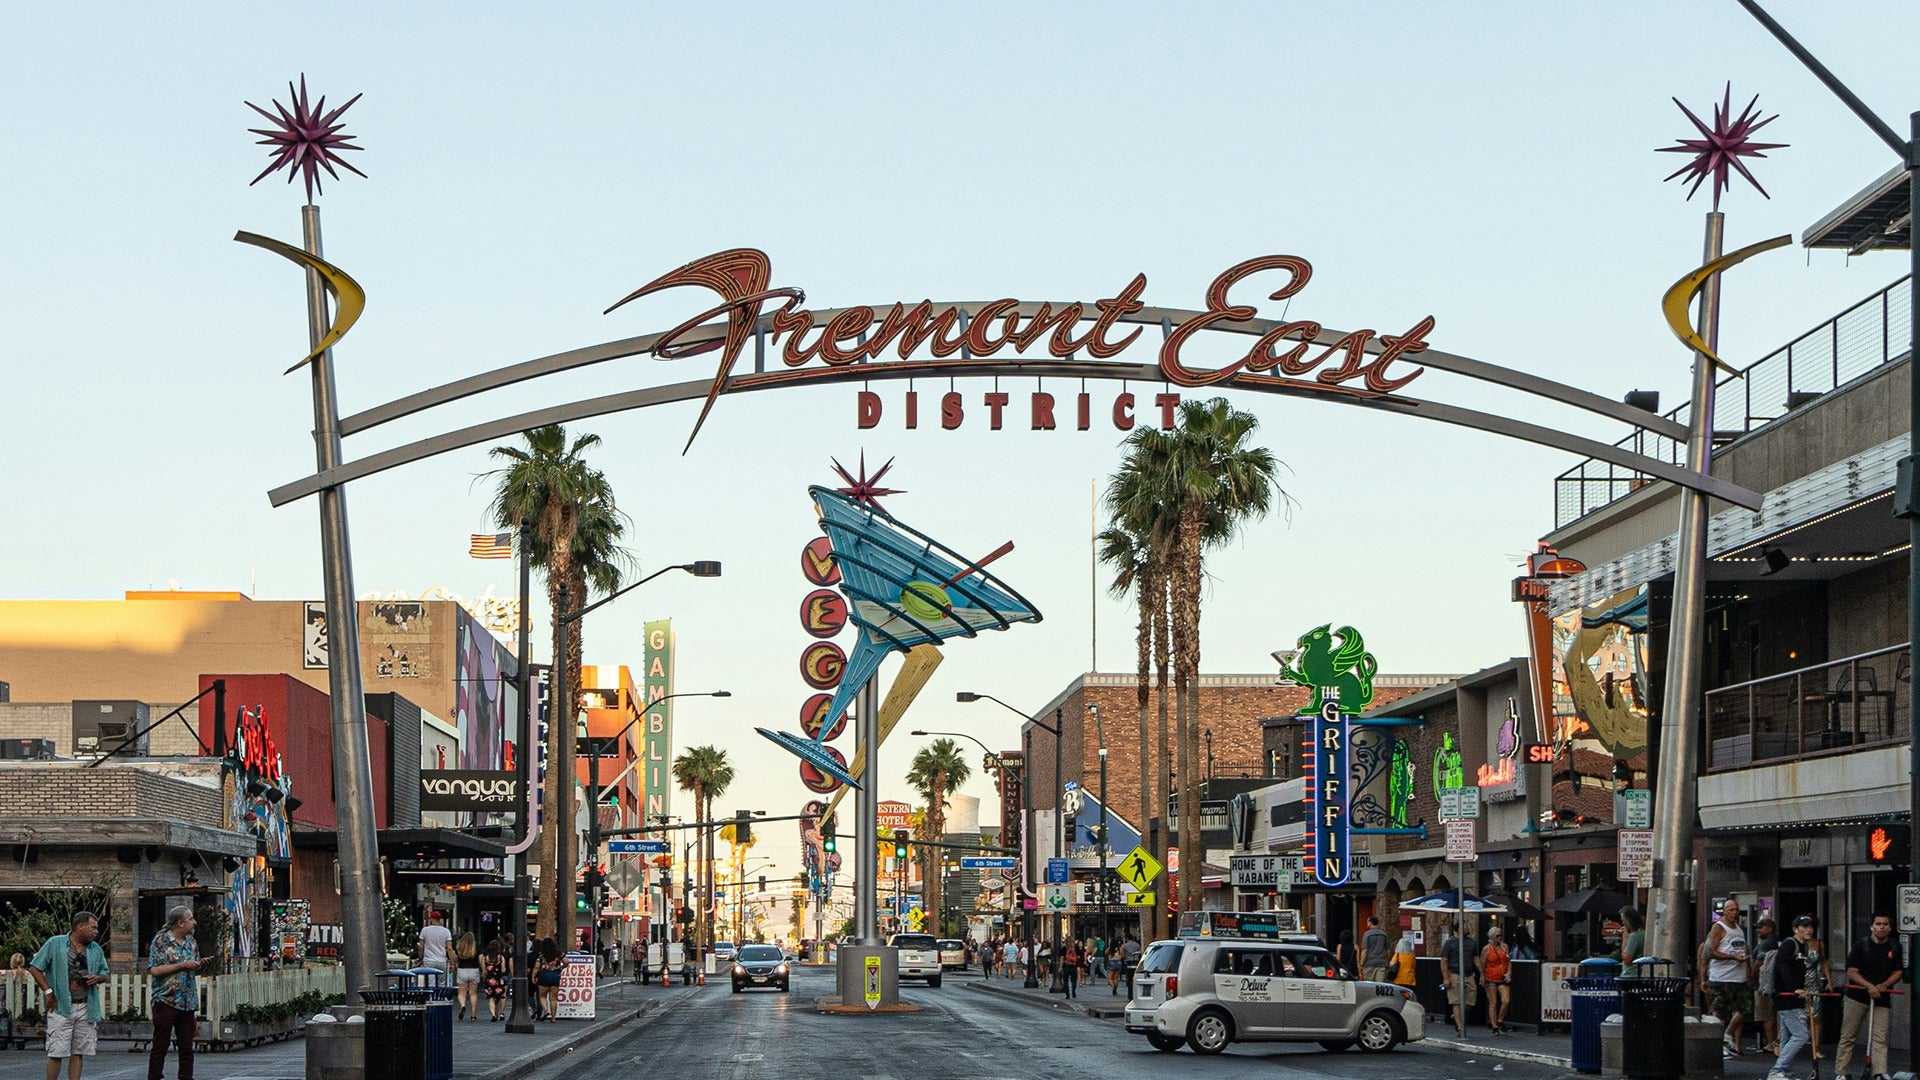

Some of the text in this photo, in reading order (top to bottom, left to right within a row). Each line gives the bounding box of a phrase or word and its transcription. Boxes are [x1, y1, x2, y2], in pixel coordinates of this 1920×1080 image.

[603, 247, 1435, 457] Fremont East
[858, 391, 1181, 431] DISTRICT
[1321, 686, 1340, 699] THE
[422, 779, 517, 801] vanguar
[1321, 702, 1341, 879] GRIFFIN
[877, 803, 910, 814] ESTERN
[624, 842, 656, 851] 6th Street
[1232, 859, 1256, 871] HOME
[1263, 858, 1275, 870] OF
[1281, 857, 1298, 870] THE
[1902, 916, 1916, 925] OK
[309, 925, 344, 942] ATM
[560, 977, 593, 988] BEER
[1240, 977, 1269, 992] Deluxe
